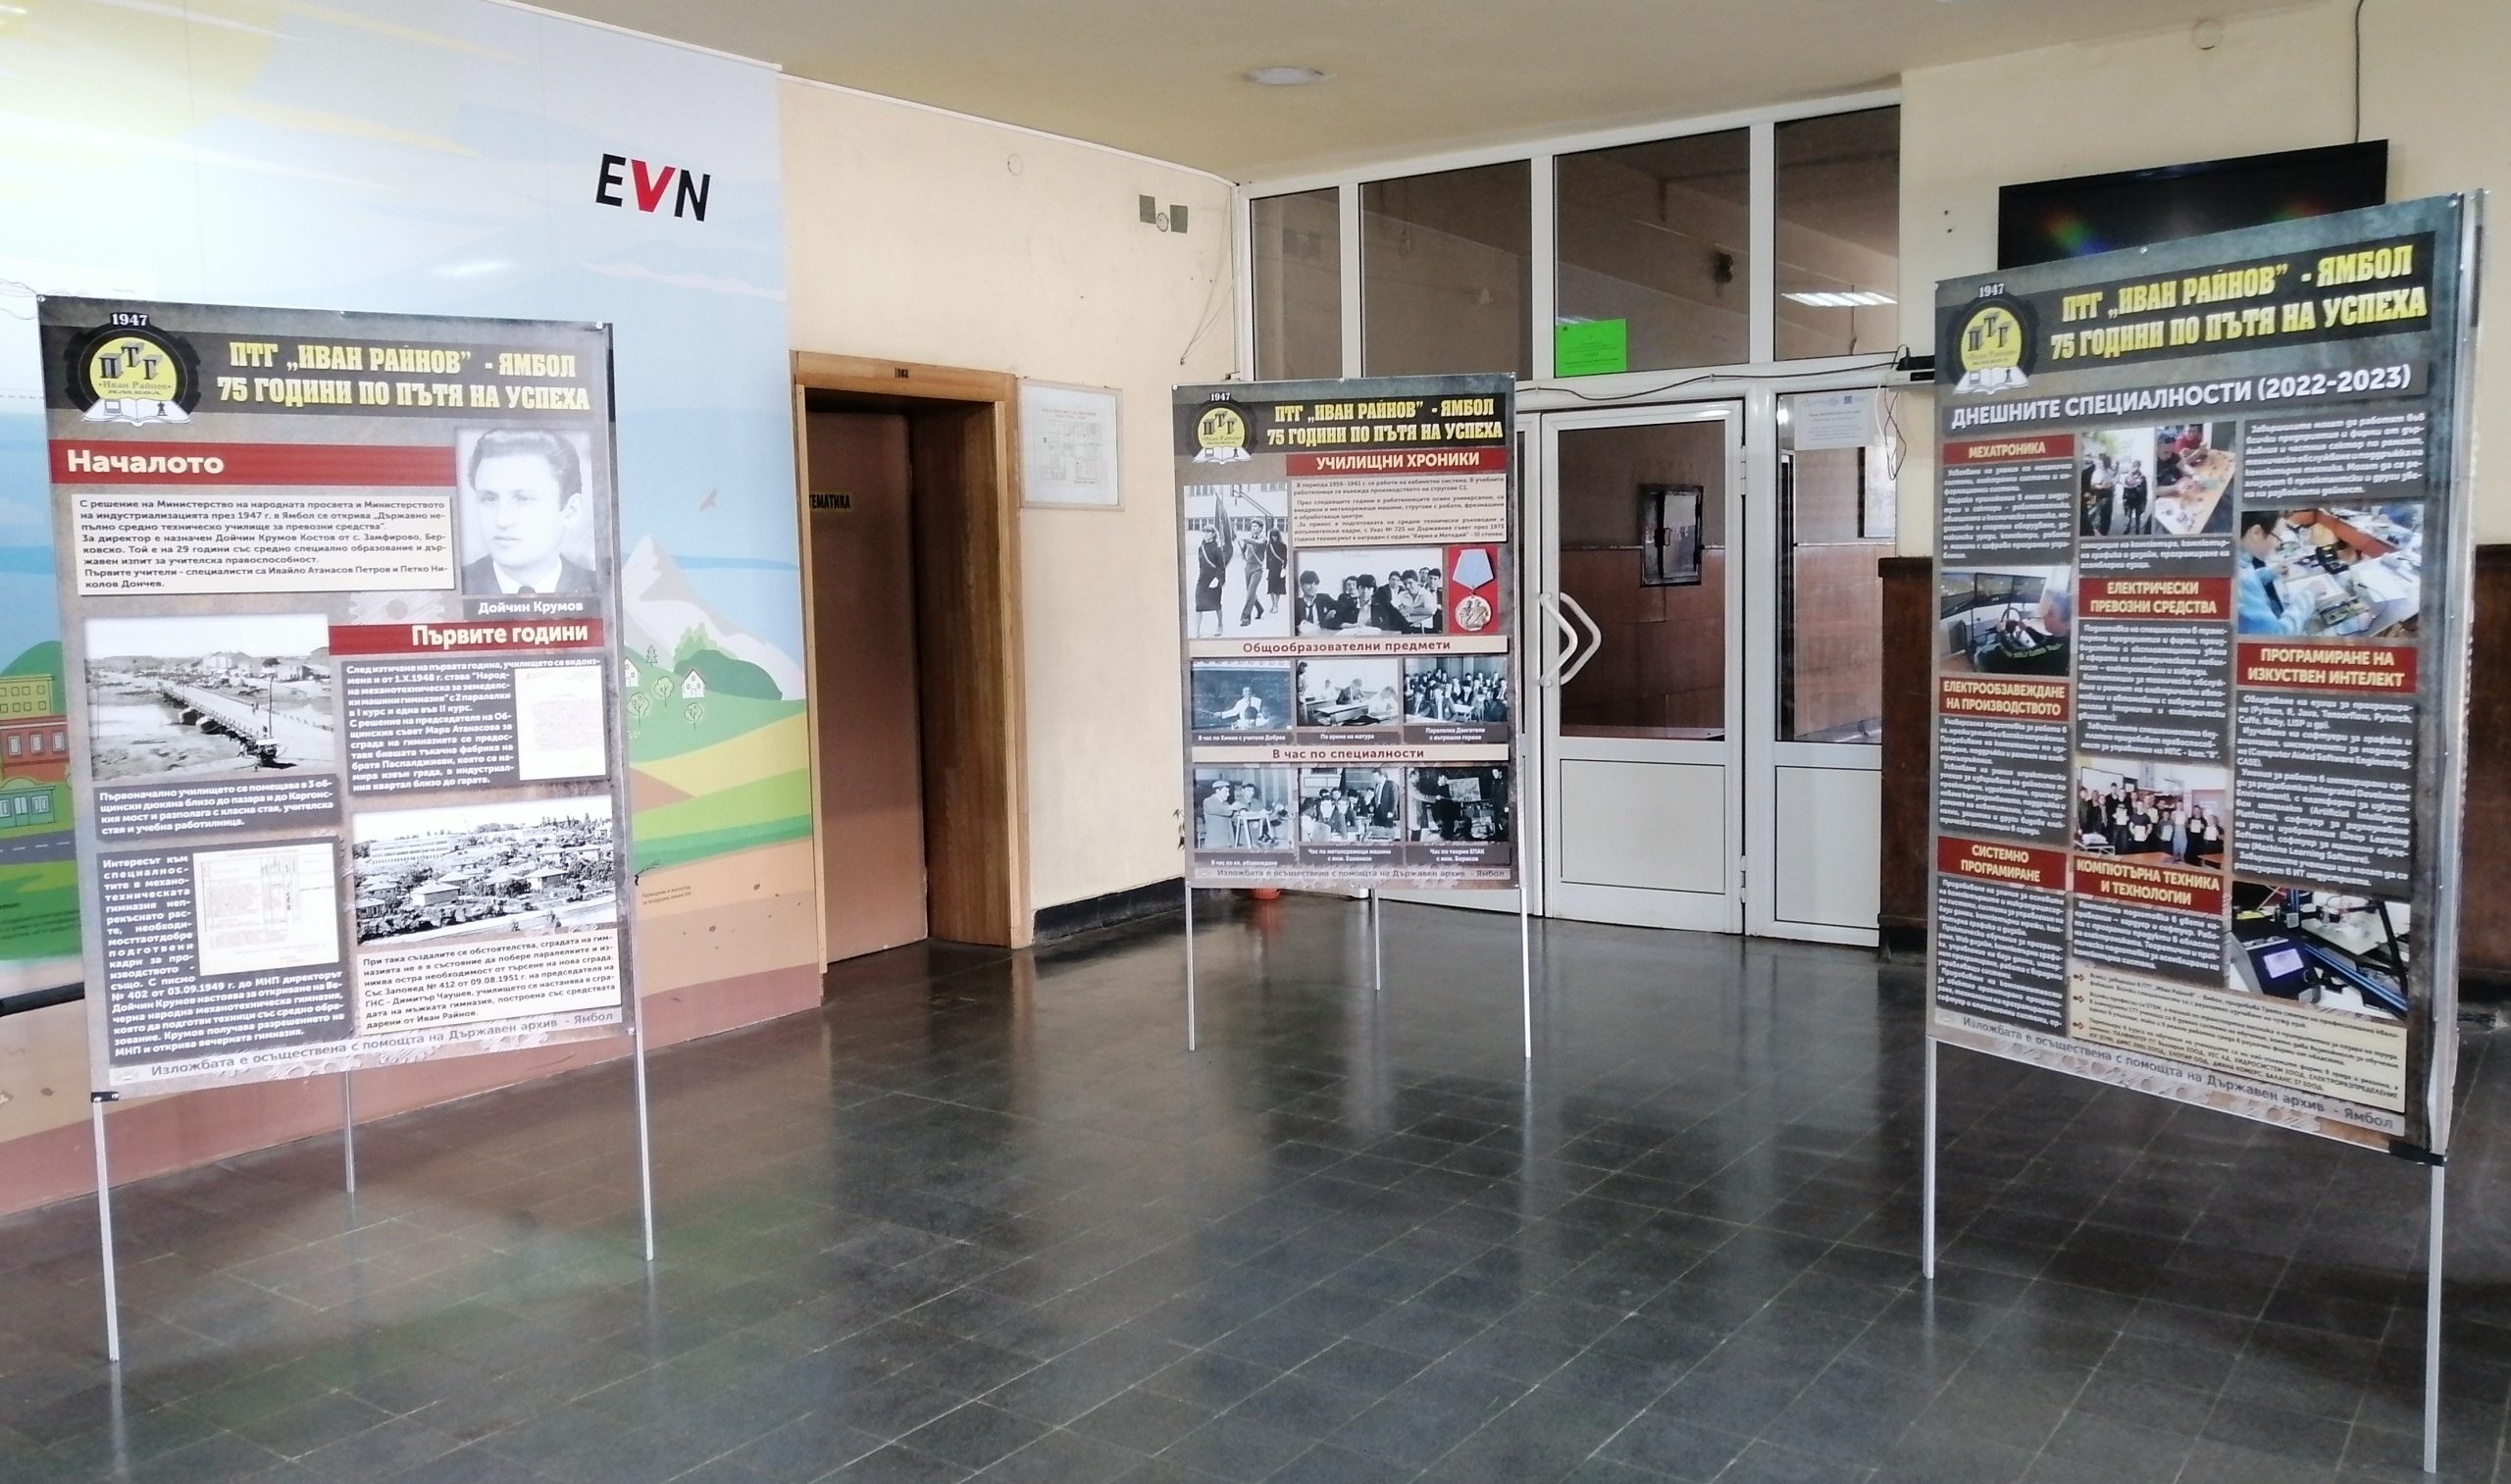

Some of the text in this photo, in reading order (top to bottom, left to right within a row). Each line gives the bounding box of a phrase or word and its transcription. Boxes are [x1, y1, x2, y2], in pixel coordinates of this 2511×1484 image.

[595, 153, 711, 223] EVN
[1977, 281, 2006, 299] 1947
[2062, 290, 2102, 322] ПТГ
[2317, 245, 2411, 287] ЯМБОЛ
[112, 313, 148, 327] 1947
[2049, 333, 2075, 361] 75
[2079, 321, 2164, 357] ГОДИНИ
[2169, 316, 2200, 344] ПО
[2204, 306, 2275, 339] ПЪТЯ
[2280, 301, 2315, 332] НА
[2323, 287, 2427, 328] УСПЕХА
[98, 341, 163, 381] ПТГ
[229, 341, 279, 369] ПТГ
[497, 351, 576, 378] ЯМБОЛ
[217, 377, 589, 411] 75 ГОДИНИ ПО ПЪТЯ НА УСПЕХА
[1209, 392, 1232, 402] 1947
[1951, 364, 2411, 428] ДНЕШНИТЕ СПЕЦИАЛНОСТИ (2022-2023)
[1274, 405, 1304, 423] ПТГ
[1440, 398, 1494, 416] ЯМБОЛ
[1266, 421, 1503, 446] 75 ГОДИНИ ПО ПЪТЯ НА УСПЕХА
[1968, 440, 2046, 460] МЕХАТРОНИКА
[67, 448, 225, 476] Началото
[1315, 452, 1479, 470] УЧИЛИЩНИ ХРОНИКИ
[156, 499, 233, 509] Министерство
[215, 534, 255, 542] Дойчин
[258, 534, 296, 542] Крумов
[2106, 579, 2199, 597] ЕЛЕКТРИЧЕСКИ
[478, 600, 584, 615] Дойчин Крумов
[2089, 599, 2217, 615] ПРЕВОЗНИ СРЕДСТВА
[411, 624, 589, 649] Първите години
[1243, 641, 1450, 655] Общообразователни предмети
[2260, 647, 2394, 665] ПРОГРАМИРАНЕ НА
[2247, 667, 2405, 688] ИЗКУСТВЕН ИНТЕЛЕКТ
[1943, 679, 2066, 701] ЕЛЕКТРООБЗАВЕЖДАНЕ
[1945, 697, 2062, 717] НА ПРОИЗВОДСТВОТО
[1272, 748, 1423, 762] В час по специалности
[99, 788, 178, 801] Първоначално
[178, 785, 235, 797] училището
[248, 781, 300, 793] помещава
[1971, 844, 2030, 865] СИСТЕМНО
[1960, 858, 2041, 884] ПРОГРАМИРАНЕ
[2075, 858, 2221, 892] КОМПЮТЪРНА ТЕХНИКА
[2100, 880, 2192, 905] И ТЕХНОЛОГИИ
[362, 956, 382, 967] При
[384, 954, 405, 964] така
[407, 949, 455, 962] създалите
[539, 938, 579, 949] сградата
[366, 1018, 401, 1032] дарени
[416, 1014, 439, 1024] Иван
[151, 1057, 233, 1075] Изложбата
[239, 1055, 247, 1064] е
[252, 1045, 346, 1063] осъществена
[351, 1043, 357, 1051] с
[362, 1036, 424, 1050] помощта
[429, 1033, 443, 1043] на
[448, 1025, 516, 1043] Държавен
[520, 1018, 558, 1034] архив
[573, 1012, 614, 1025] Ямбол
[1963, 1015, 2022, 1041] Изложбата
[2034, 1035, 2111, 1061] осъществена
[2125, 1055, 2182, 1078] помощта
[2206, 1072, 2278, 1100] Държавен
[2281, 1093, 2326, 1112] архив
[2344, 1107, 2394, 1130] Ямбол
